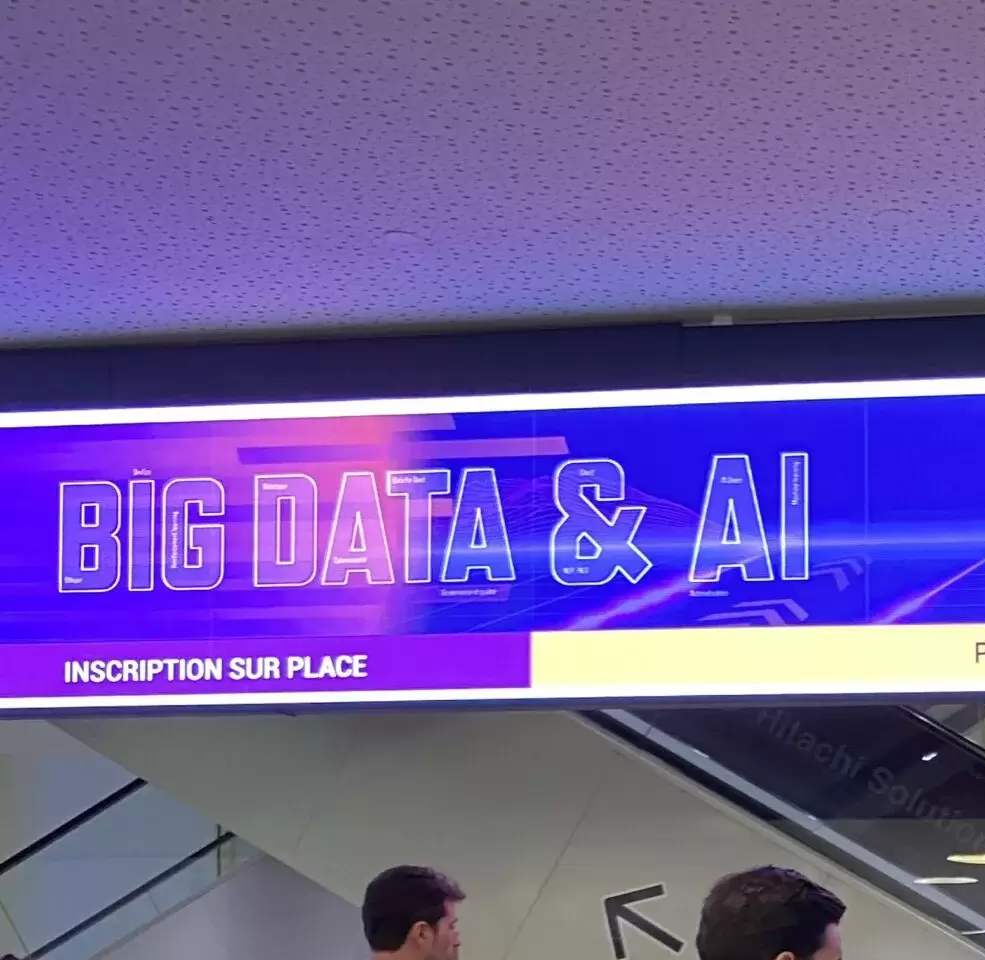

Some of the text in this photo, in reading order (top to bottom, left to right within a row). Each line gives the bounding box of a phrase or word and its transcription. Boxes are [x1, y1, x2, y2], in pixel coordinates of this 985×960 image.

[58, 477, 225, 593] BIG
[253, 467, 516, 587] DATA
[550, 458, 653, 586] &
[689, 451, 809, 583] AI
[64, 654, 369, 684] INSCRIPTION SUR PLACE
